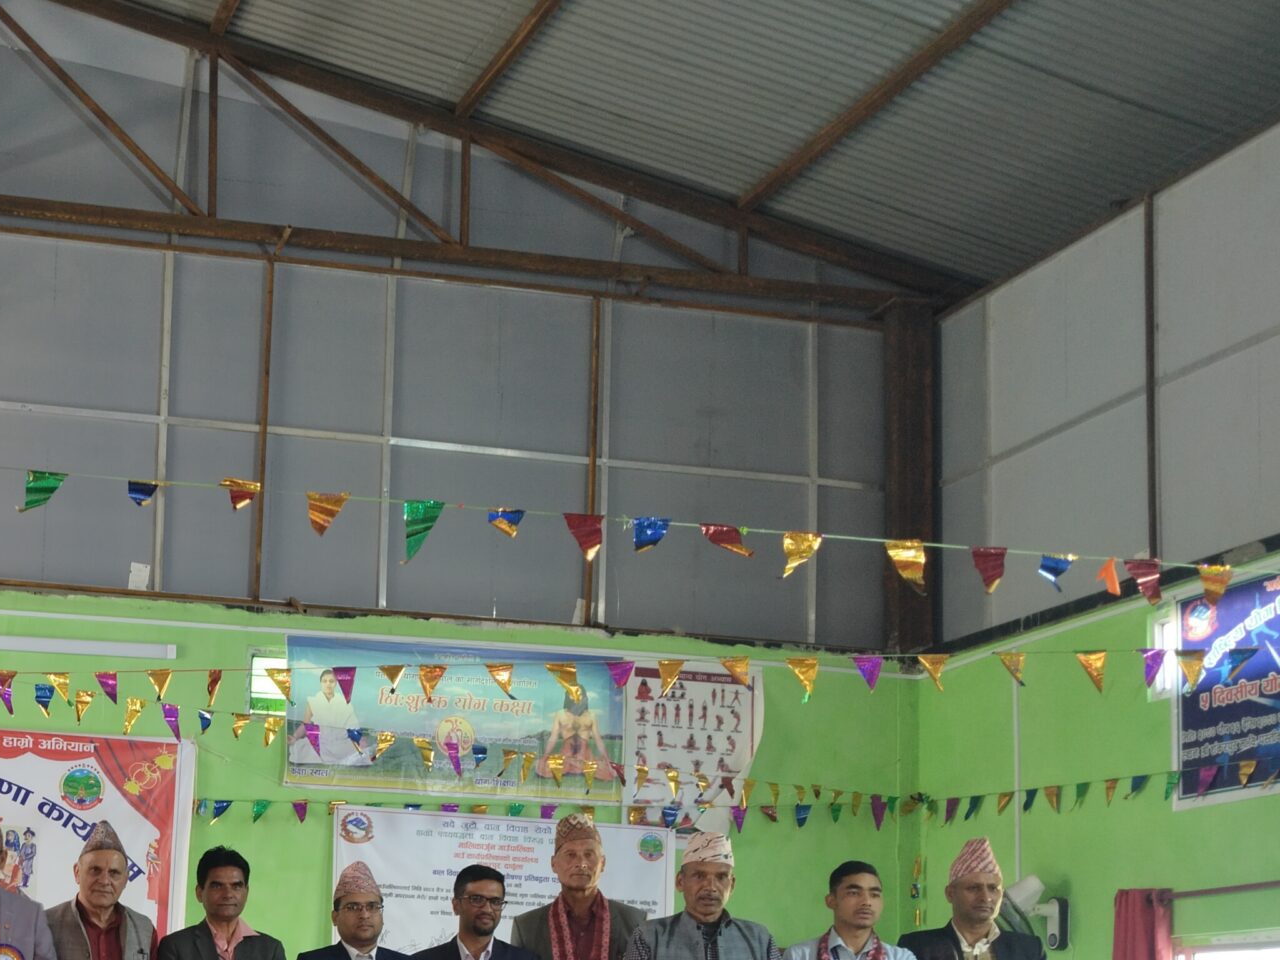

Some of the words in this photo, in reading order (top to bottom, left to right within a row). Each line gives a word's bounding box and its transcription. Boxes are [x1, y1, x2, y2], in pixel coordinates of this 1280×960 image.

[454, 691, 487, 713] योग
[493, 698, 534, 717] कक्षा
[1212, 679, 1260, 707] दिवसीय
[2, 735, 33, 749] हाम्रो
[38, 737, 98, 753] अभियान
